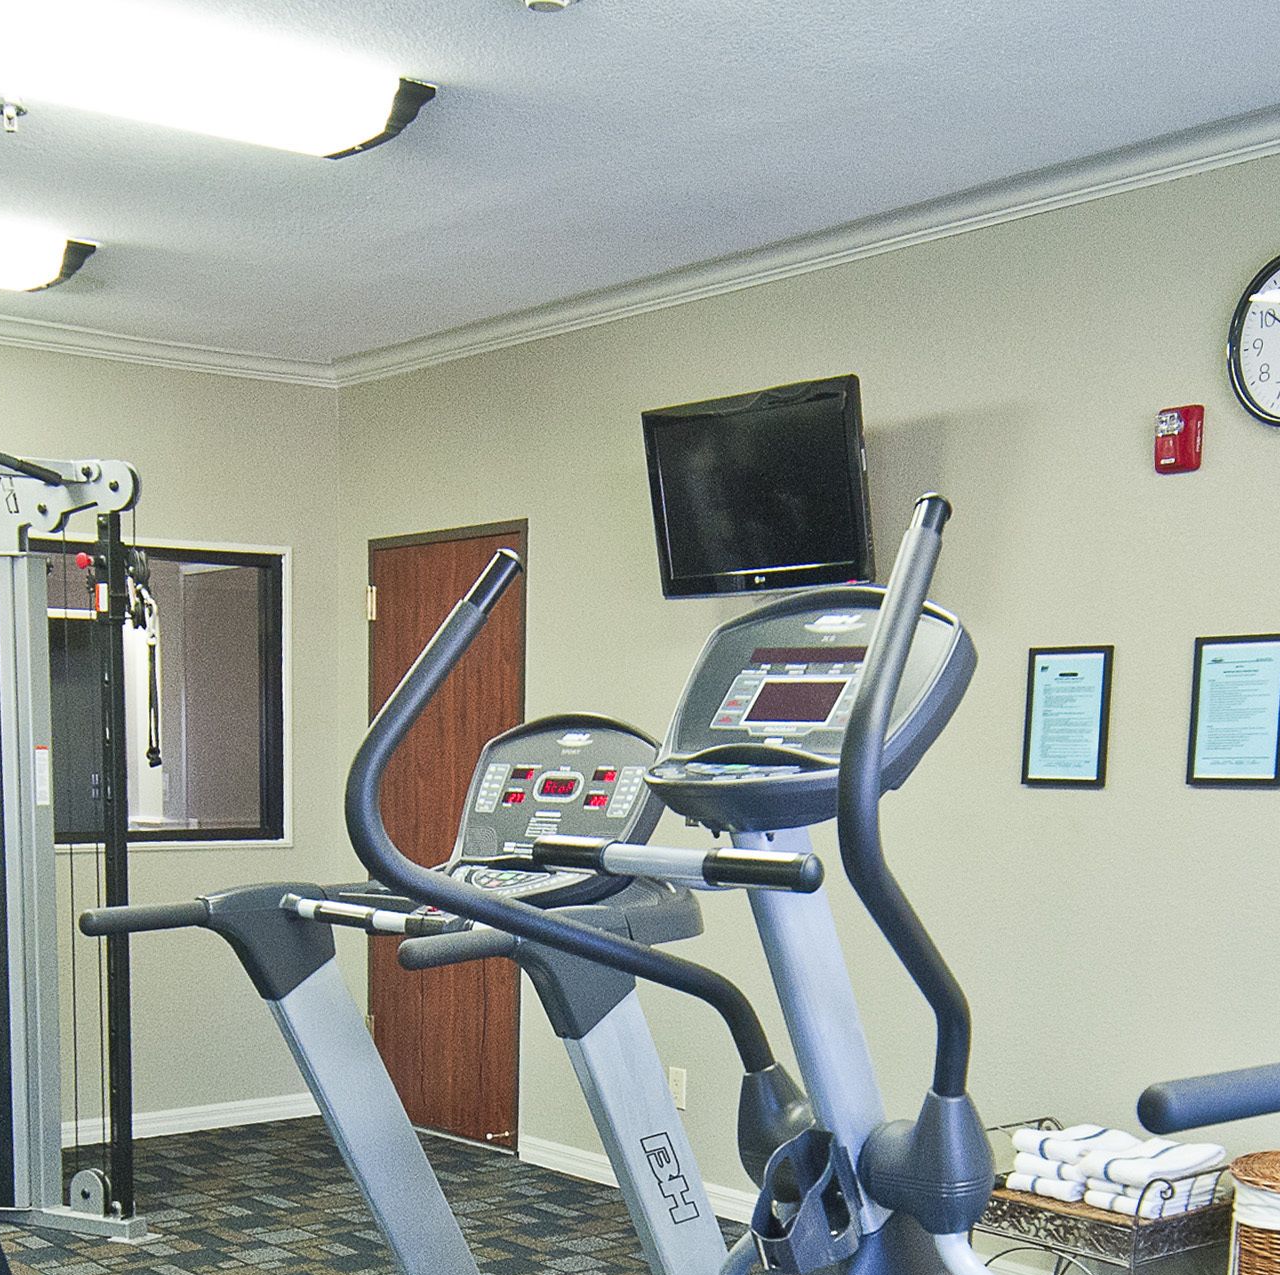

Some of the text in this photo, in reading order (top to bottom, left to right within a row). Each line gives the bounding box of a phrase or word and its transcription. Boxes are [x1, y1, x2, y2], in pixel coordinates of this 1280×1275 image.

[1260, 308, 1276, 329] 10
[1252, 338, 1264, 357] 9
[1258, 363, 1270, 383] 8
